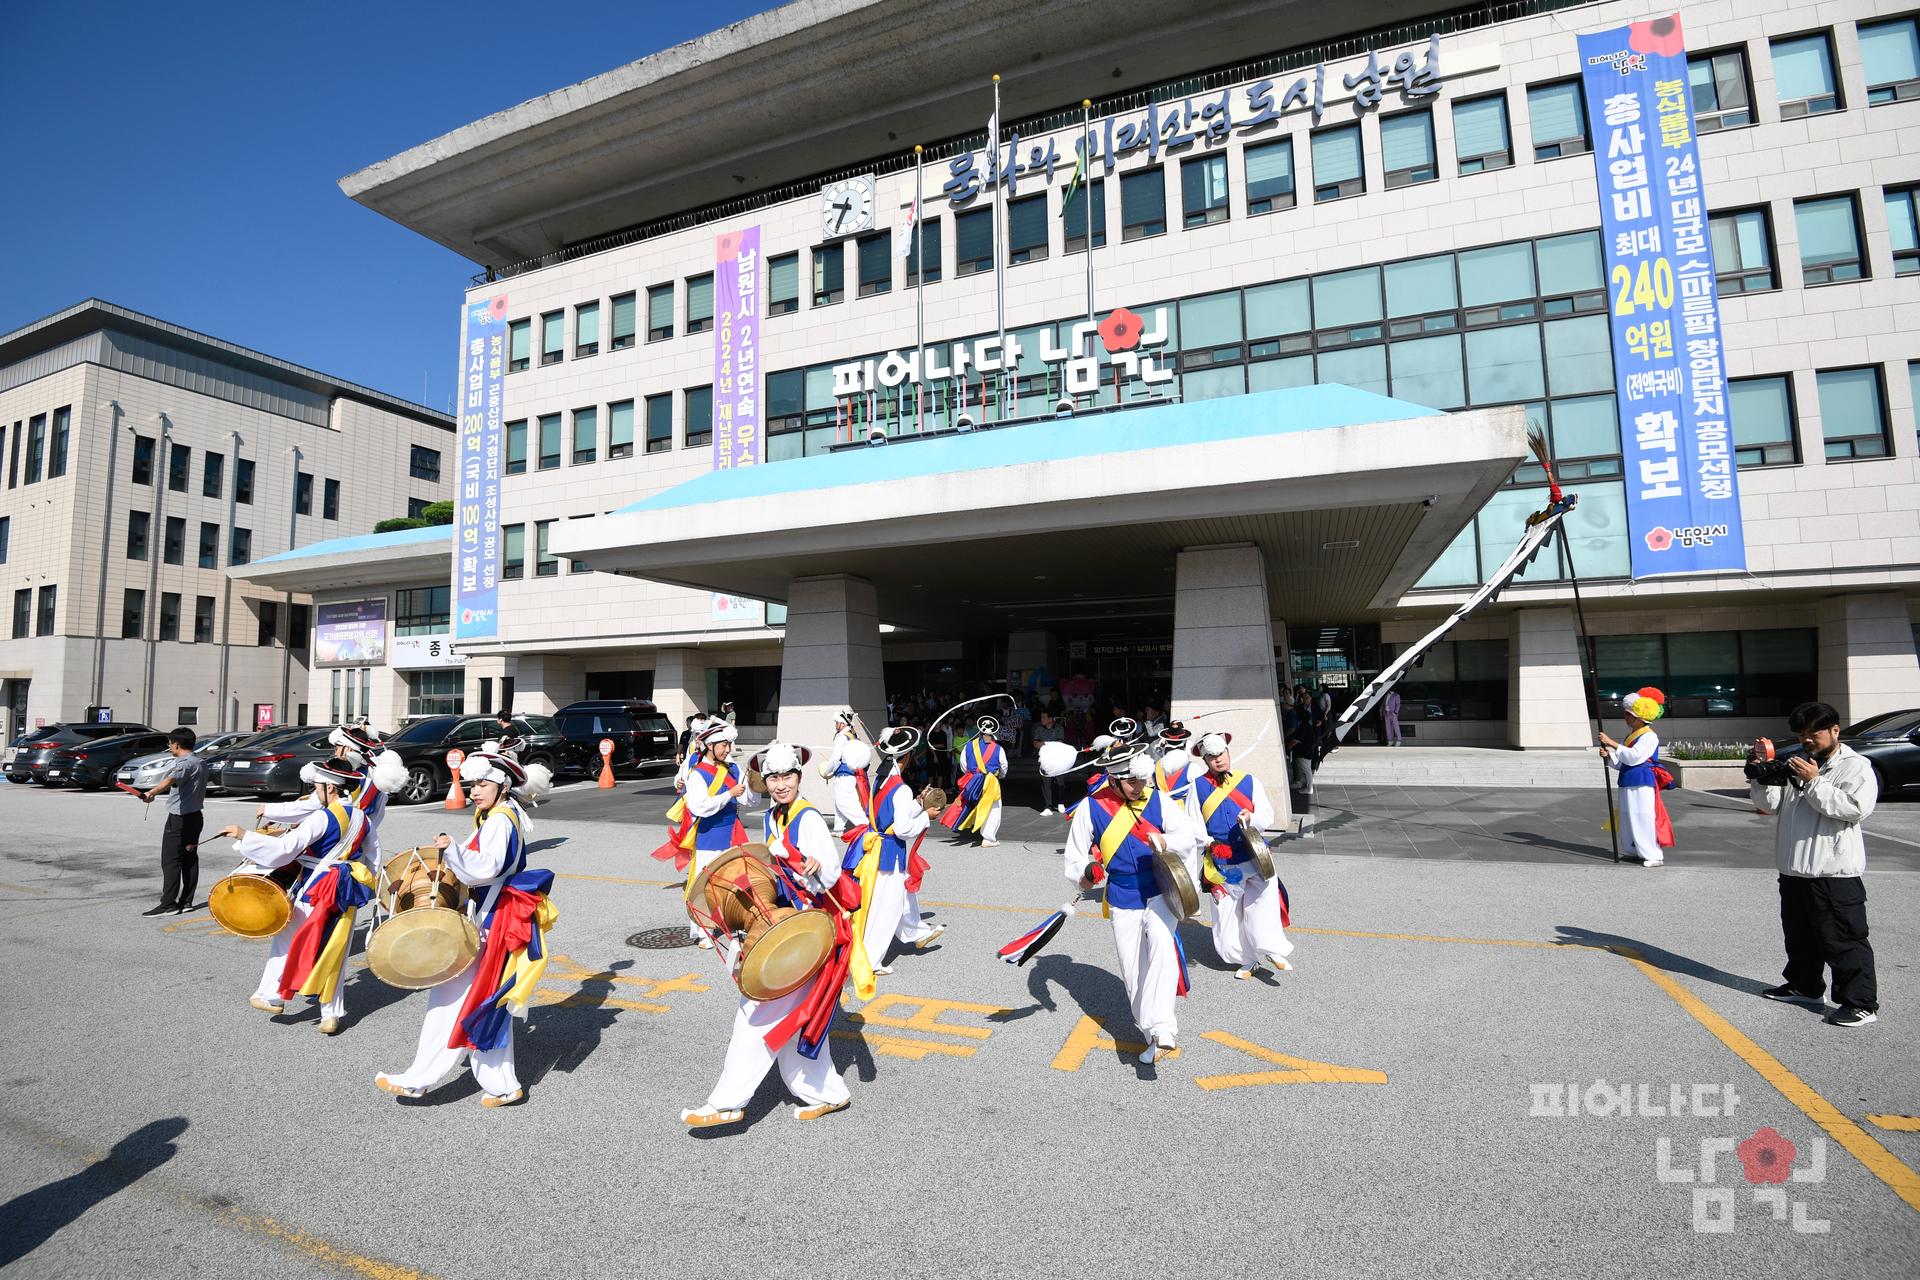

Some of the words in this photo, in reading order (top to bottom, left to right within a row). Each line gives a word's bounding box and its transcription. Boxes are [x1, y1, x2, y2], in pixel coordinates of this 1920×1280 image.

[1588, 51, 1629, 66] 피어나다
[1612, 54, 1648, 76] 남원
[1075, 88, 1231, 168] 미래산업
[1238, 63, 1325, 126] 도시
[1343, 33, 1433, 107] 남원
[1654, 79, 1692, 149] 농식품부
[1603, 92, 1652, 221] 총사업비
[1665, 153, 1698, 196] 24년
[1615, 226, 1661, 257] 최대
[1670, 198, 1707, 256] 대규모
[737, 248, 756, 320] 남원시
[1677, 259, 1716, 335] 스마트팜
[469, 337, 485, 408] 총사업비
[489, 335, 503, 380] 농식품부
[720, 311, 732, 394] 2024년
[833, 334, 1025, 398] 피어나다
[1039, 306, 1175, 395] 남원
[1686, 338, 1724, 416] 창업단지
[487, 383, 501, 431] 곤충산업
[1626, 367, 1684, 401] (전액국비)
[485, 434, 499, 480] 거점단지
[1634, 410, 1682, 500] 확보
[484, 484, 497, 533] 조성사업
[1674, 525, 1728, 547] 남원시
[483, 564, 496, 589] 선정
